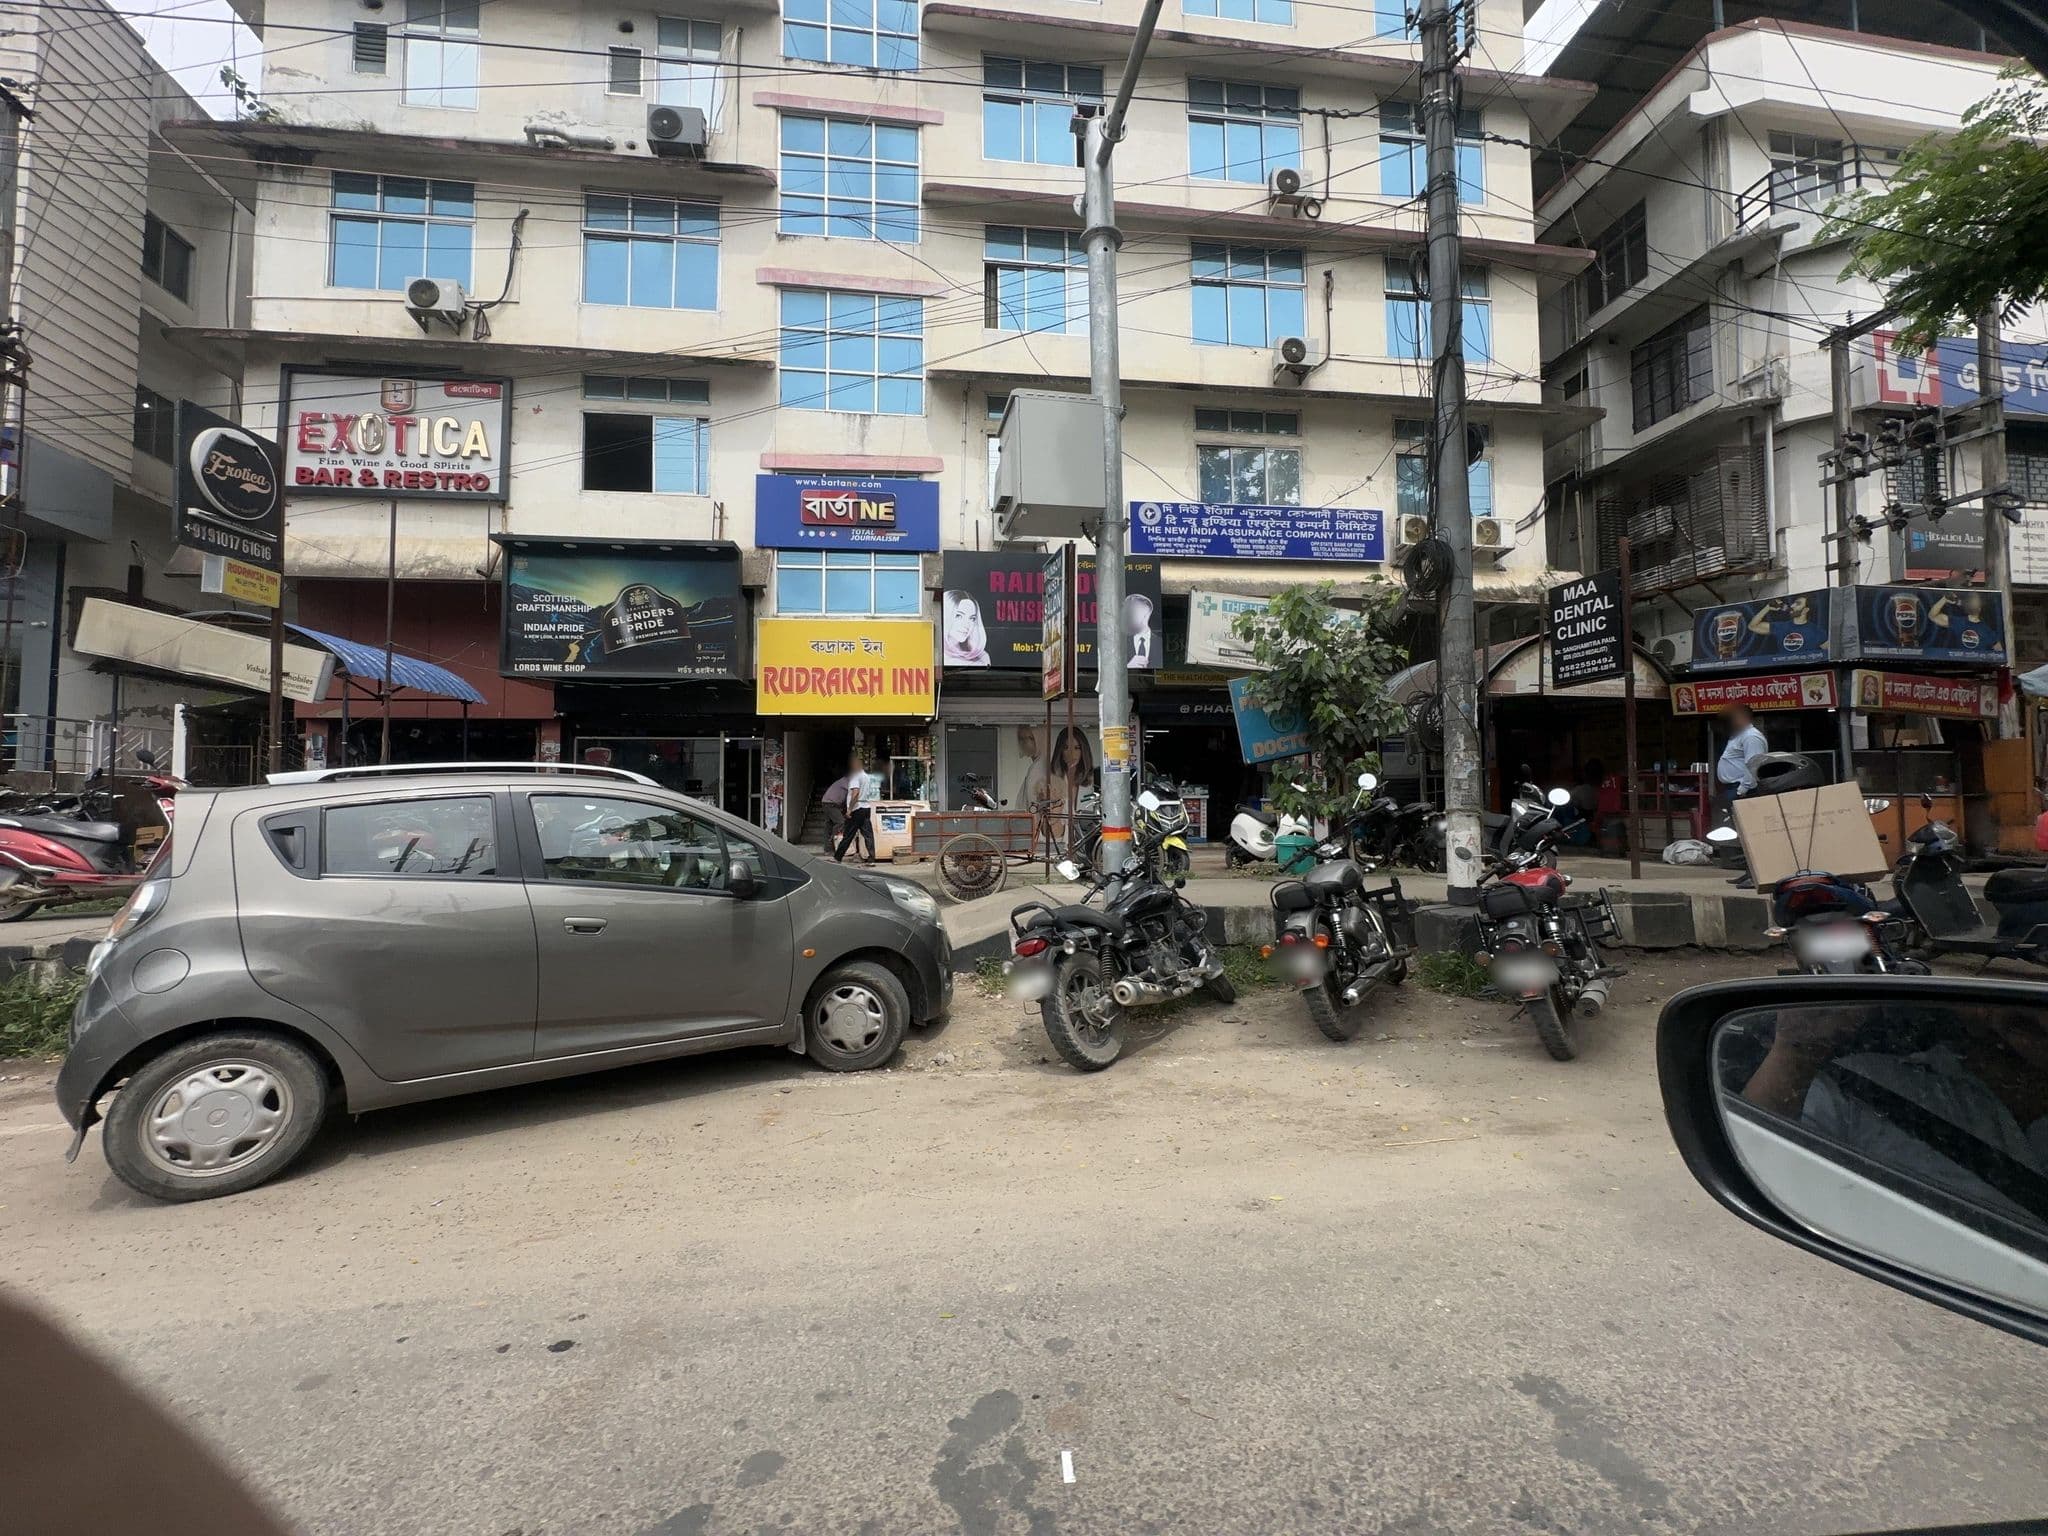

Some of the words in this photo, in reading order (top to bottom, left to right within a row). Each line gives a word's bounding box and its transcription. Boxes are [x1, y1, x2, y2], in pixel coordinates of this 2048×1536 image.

[297, 411, 491, 461] EXOTICA
[318, 457, 345, 466] Fine
[352, 459, 380, 468] Wine
[385, 460, 394, 468] &
[400, 460, 428, 469] Good
[204, 451, 271, 492] Exotica
[296, 466, 352, 485] BAR
[358, 468, 379, 487] &
[383, 470, 490, 491] RESTRO
[795, 479, 881, 489] www.bartane.com
[861, 501, 895, 521] NE
[1142, 526, 1161, 534] THE
[1164, 526, 1188, 534] NEW
[1191, 527, 1218, 536] INDIA
[1220, 528, 1282, 538] ASSURANCE
[1286, 530, 1333, 539] COMPANY
[1336, 532, 1374, 541] LIMITED
[208, 528, 240, 550] 91017
[242, 539, 272, 560] 61616
[533, 594, 577, 603] SCOTTISH
[1563, 580, 1598, 602] MAA
[516, 603, 593, 613] CRAFTSMANSHIP
[1224, 601, 1245, 612] THE
[1554, 595, 1614, 623] DENTAL
[611, 608, 674, 627] BLENDERS
[523, 623, 556, 632] INDIAN
[557, 624, 585, 632] PRIDE
[627, 618, 665, 633] PRIDE
[1557, 616, 1607, 640] CLINIC
[616, 637, 634, 645] SELECT
[635, 632, 658, 640] PREMIUM
[246, 663, 267, 675] Vishal
[514, 663, 540, 672] LORDS
[543, 664, 562, 672] WINE
[564, 664, 586, 673] SHOP
[763, 666, 884, 697] RUDRAKSH
[892, 667, 930, 696] INN
